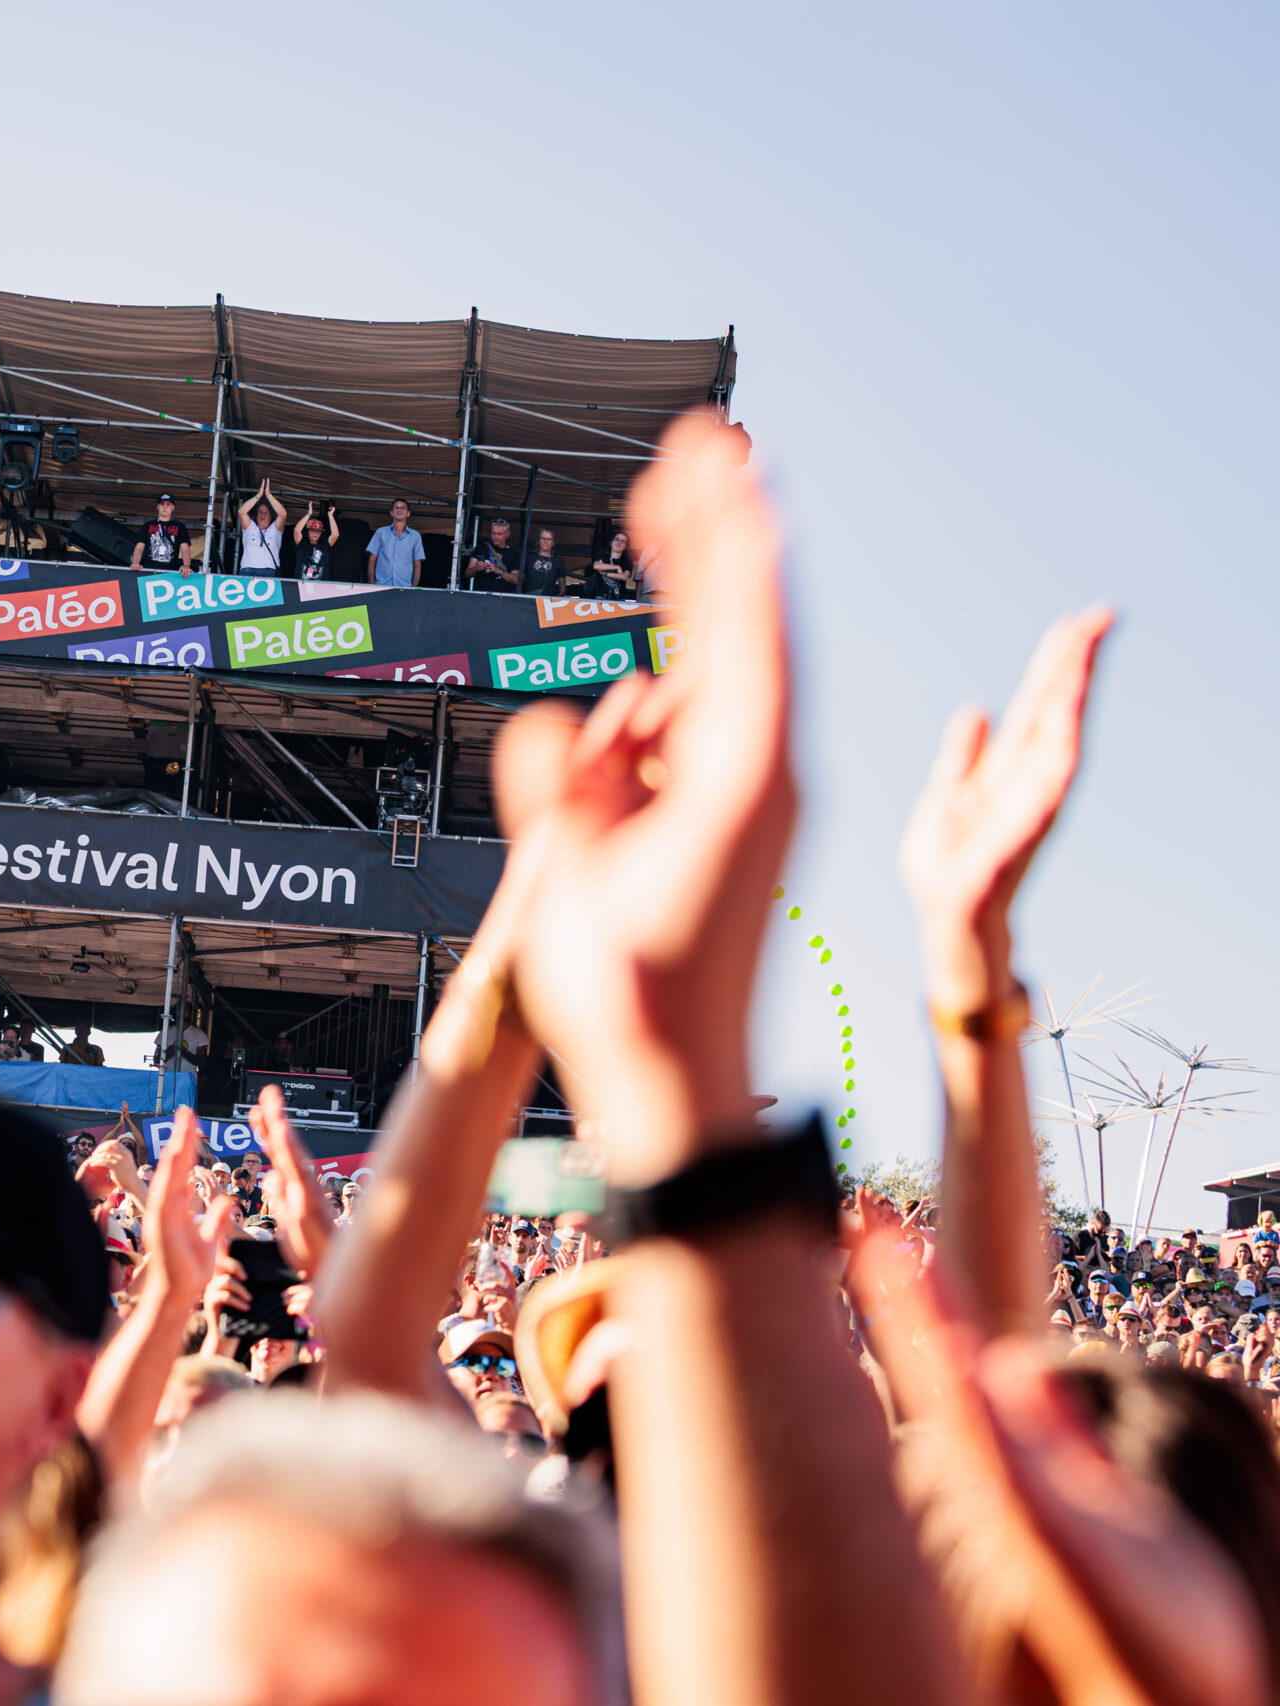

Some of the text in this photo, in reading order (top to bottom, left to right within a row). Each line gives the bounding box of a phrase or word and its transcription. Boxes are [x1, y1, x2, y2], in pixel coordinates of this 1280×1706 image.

[233, 616, 365, 663] Paléo
[496, 643, 629, 688] Paléo
[195, 845, 357, 911] Nyon
